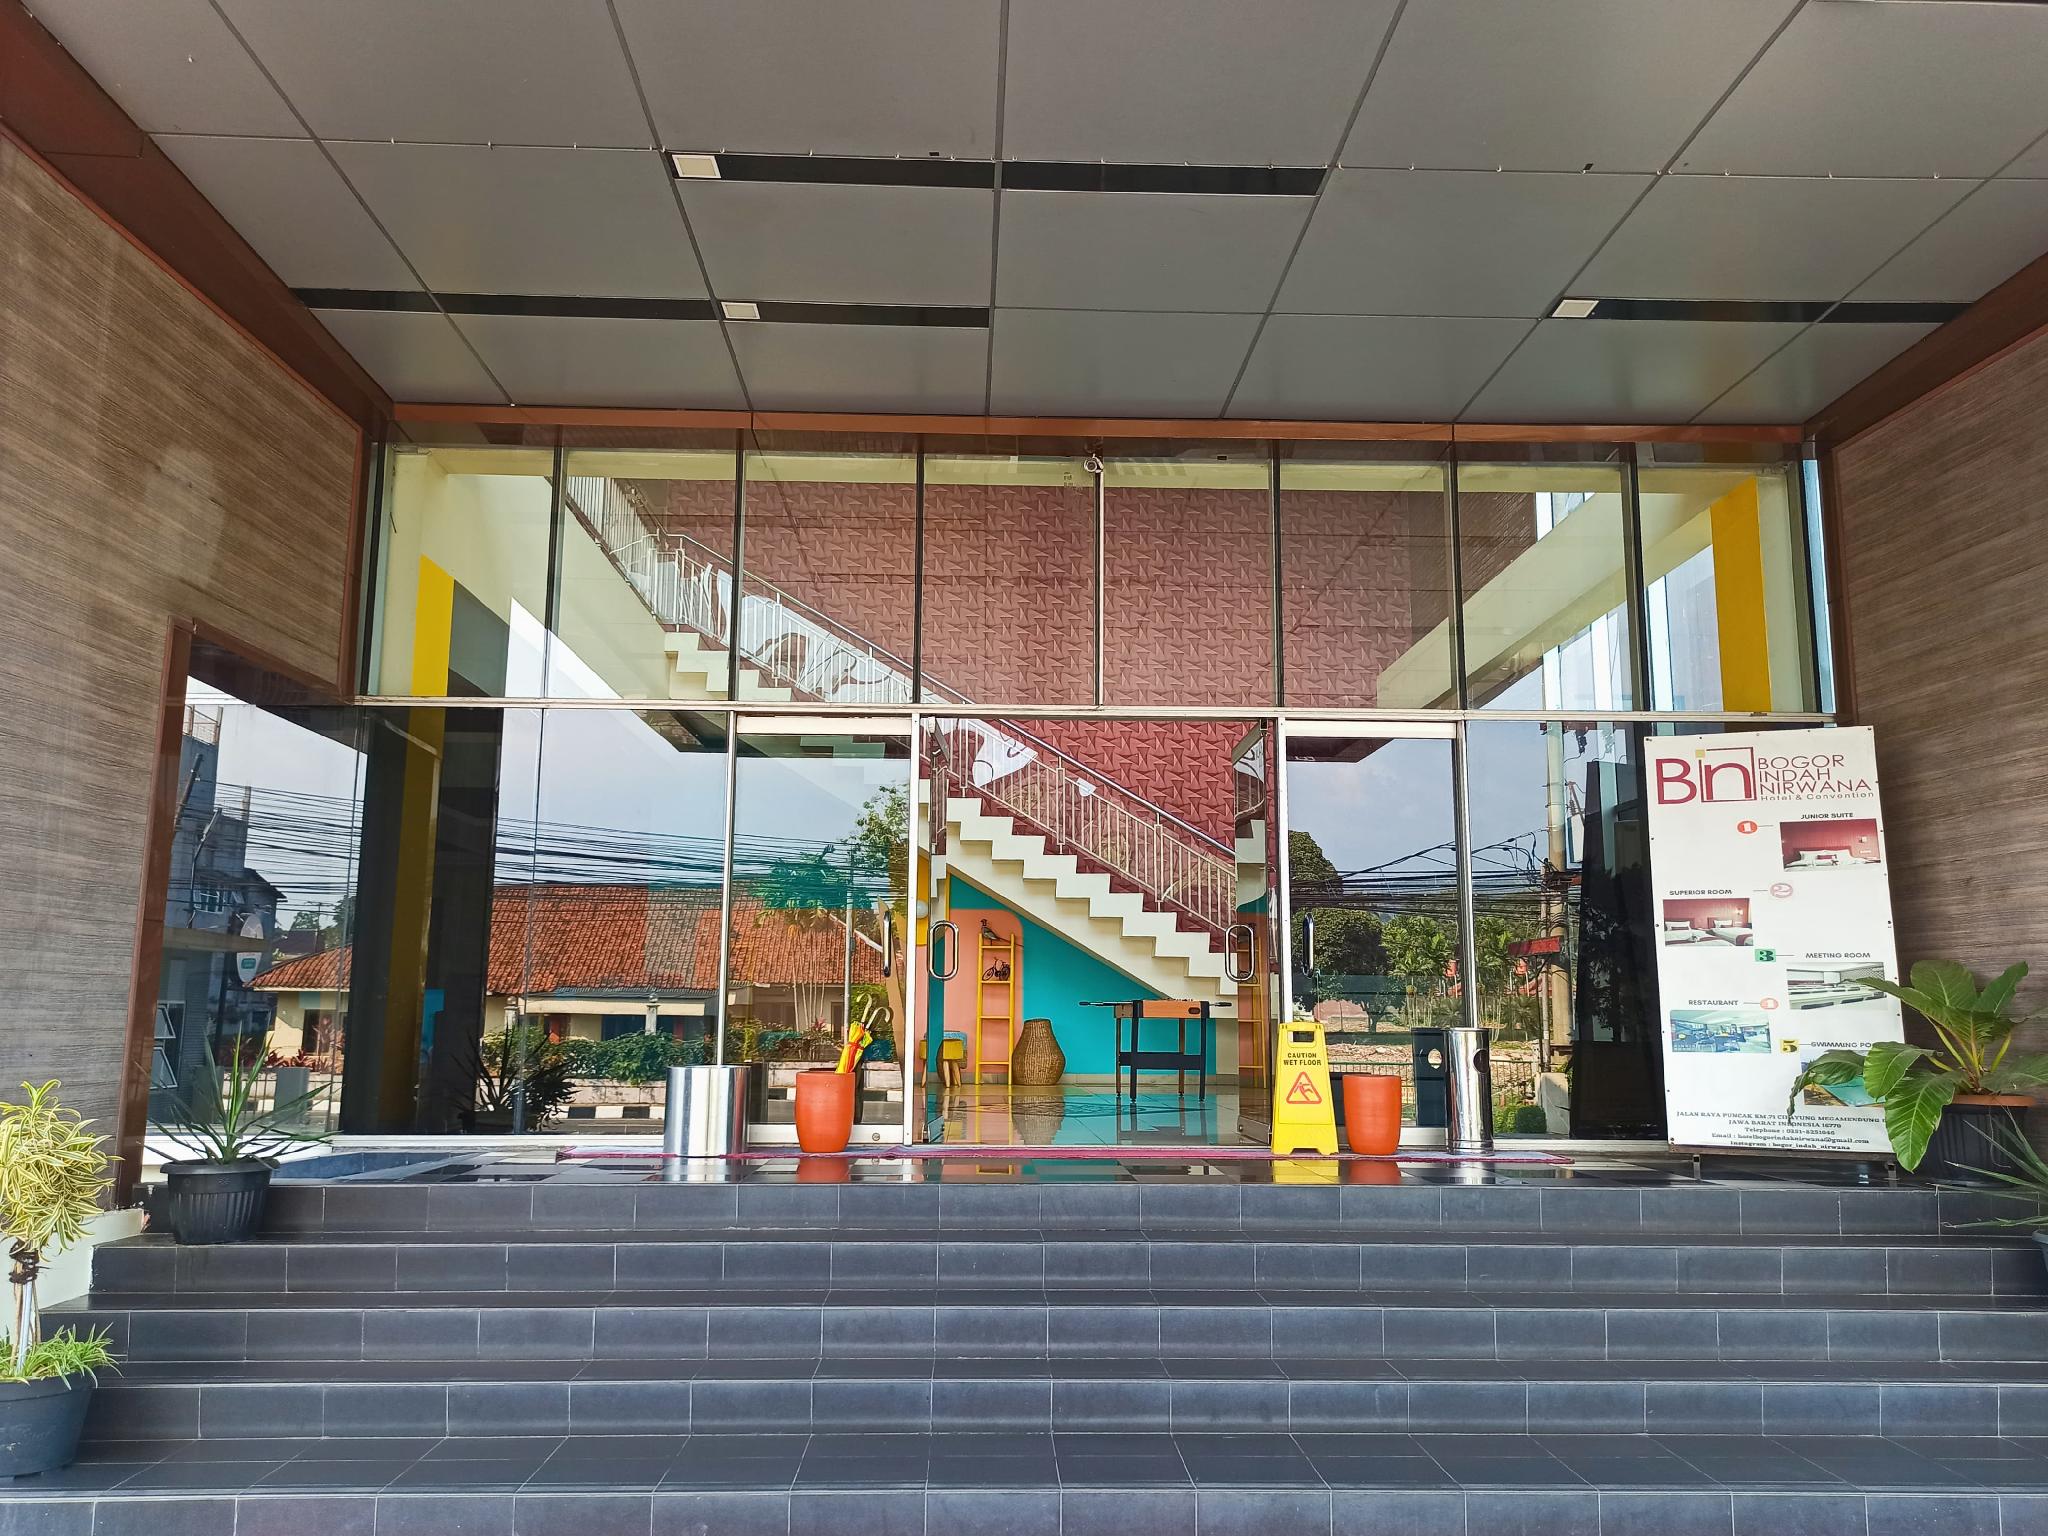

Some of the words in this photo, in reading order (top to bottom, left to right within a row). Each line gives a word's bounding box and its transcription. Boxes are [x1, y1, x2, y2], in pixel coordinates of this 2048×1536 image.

[1758, 754, 1845, 770] BOGOR
[1759, 768, 1831, 782] INDAH
[1760, 779, 1872, 795] NIRWANA
[1806, 792, 1874, 800] Convention
[1759, 950, 1775, 962] 3
[1782, 1040, 1798, 1053] 5
